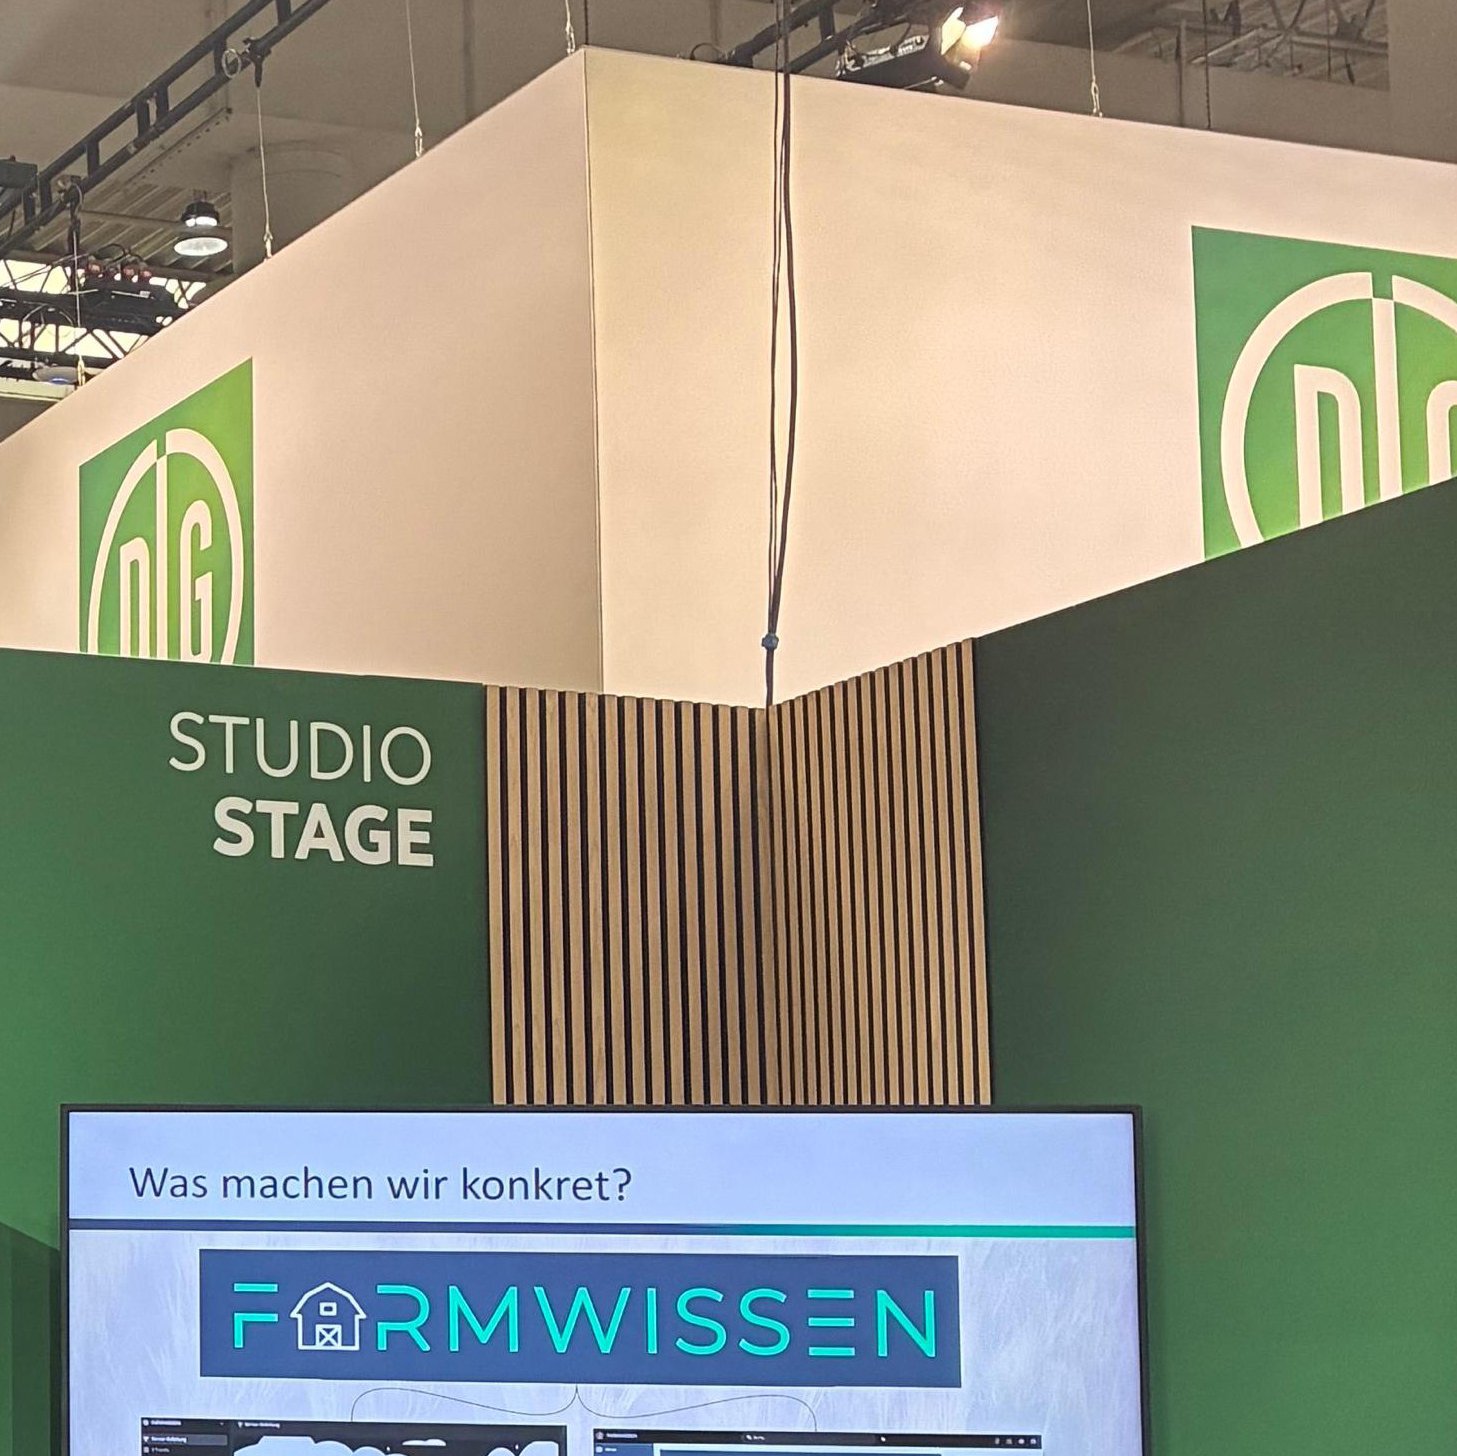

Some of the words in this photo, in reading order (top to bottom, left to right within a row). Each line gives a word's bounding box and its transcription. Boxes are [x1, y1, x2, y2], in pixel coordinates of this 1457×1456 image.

[169, 711, 432, 786] STUDIO
[213, 796, 434, 867] STAGE
[129, 1166, 208, 1198] Was
[222, 1166, 372, 1200] machen
[387, 1167, 448, 1200] wir
[462, 1167, 633, 1202] konkret?
